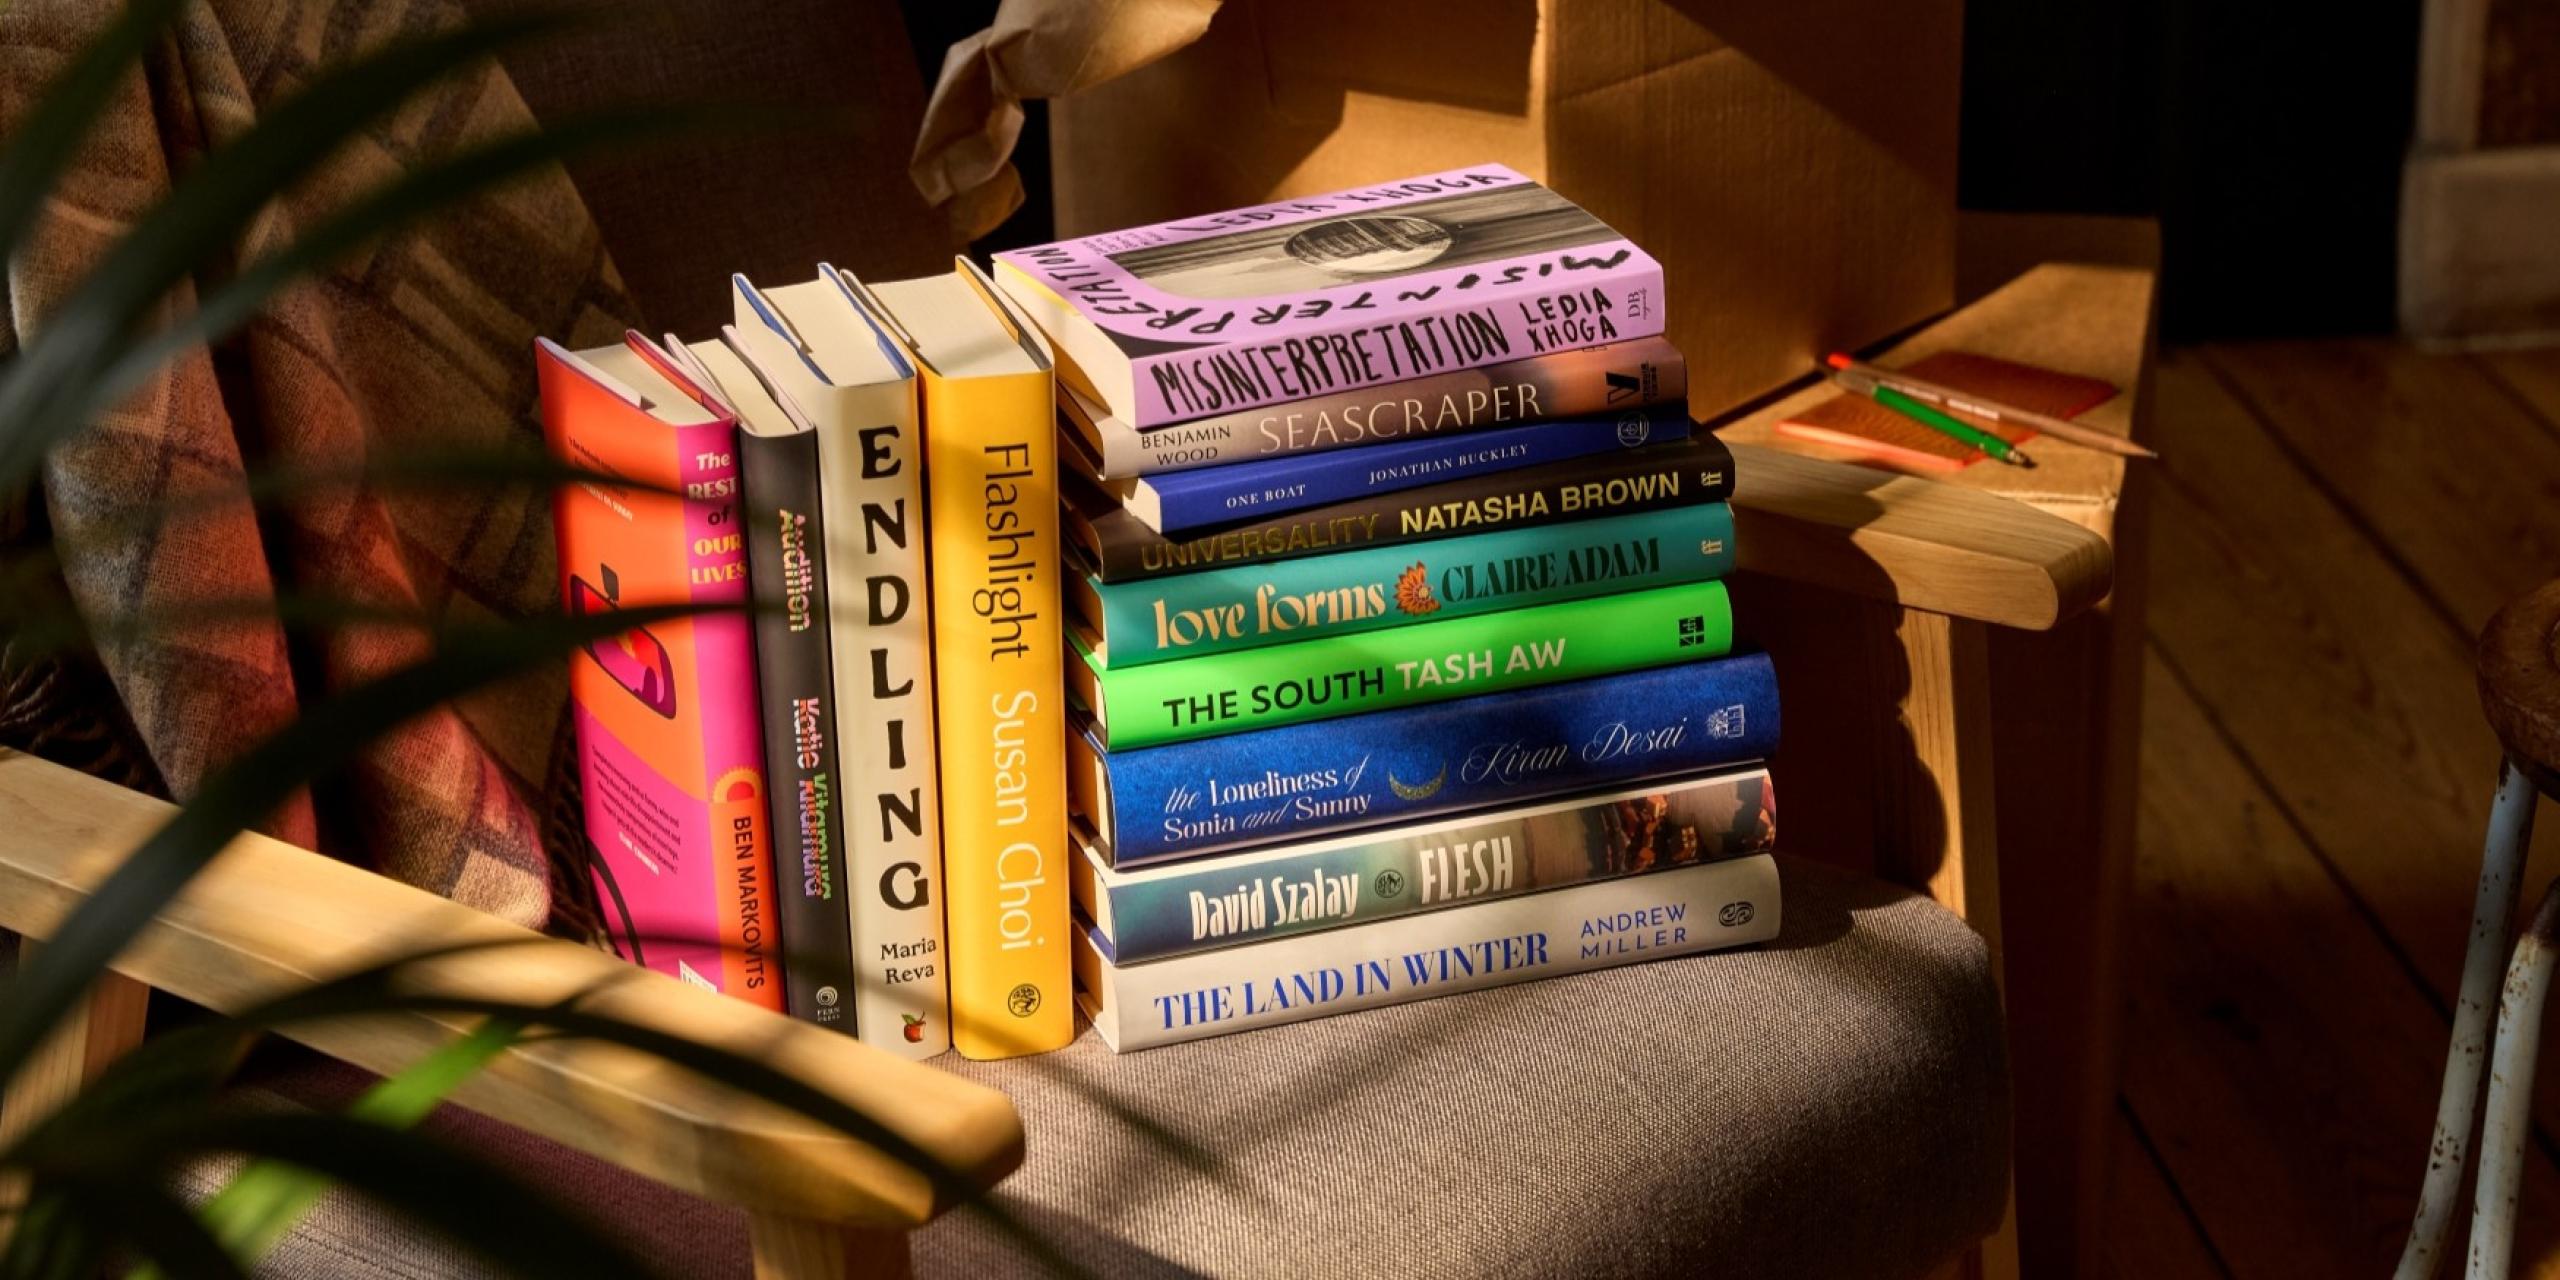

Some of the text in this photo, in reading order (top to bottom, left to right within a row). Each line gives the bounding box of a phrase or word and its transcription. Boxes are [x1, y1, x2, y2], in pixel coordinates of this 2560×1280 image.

[1166, 173, 1511, 232] LEDIA XHOGA
[1520, 287, 1614, 324] LEDIA
[1529, 315, 1618, 353] XHOGA
[1150, 306, 1512, 416] MISINTERPRETATION
[1140, 424, 1232, 450] BENJAMIN
[1258, 382, 1544, 455] SEASCRAPER
[695, 452, 731, 472] The
[1156, 446, 1219, 466] WOOD
[1368, 443, 1529, 485] JONATHAN BUCKLEY
[687, 476, 737, 500] REST
[1226, 484, 1307, 509] ONE BOAT
[707, 505, 731, 526] of
[1141, 471, 1680, 571] UNIVERSALITY NATASHA BROWN
[694, 533, 742, 557] OUR
[690, 560, 746, 585] LIVES
[1152, 537, 1661, 649] love forms CLAIRE ADAM
[972, 442, 1046, 951] Flashlight Susan Choi
[1163, 638, 1566, 727] THE SOUTH TASH AW
[779, 509, 832, 900] Audition Katie Kitamura
[1461, 717, 1688, 786] Kiran Desai
[1165, 753, 1371, 814] the Loneliness of
[1163, 793, 1372, 842] Sonia and Sunny
[734, 816, 766, 989] BEN MARKOVITS
[1188, 835, 1514, 941] David Szalay FLESH
[1579, 903, 1688, 939] ANDREW
[880, 937, 937, 961] Maria
[1579, 928, 1688, 961] MILLER
[885, 963, 936, 985] Reva
[1153, 931, 1549, 1030] THE LAND IN WINTER
